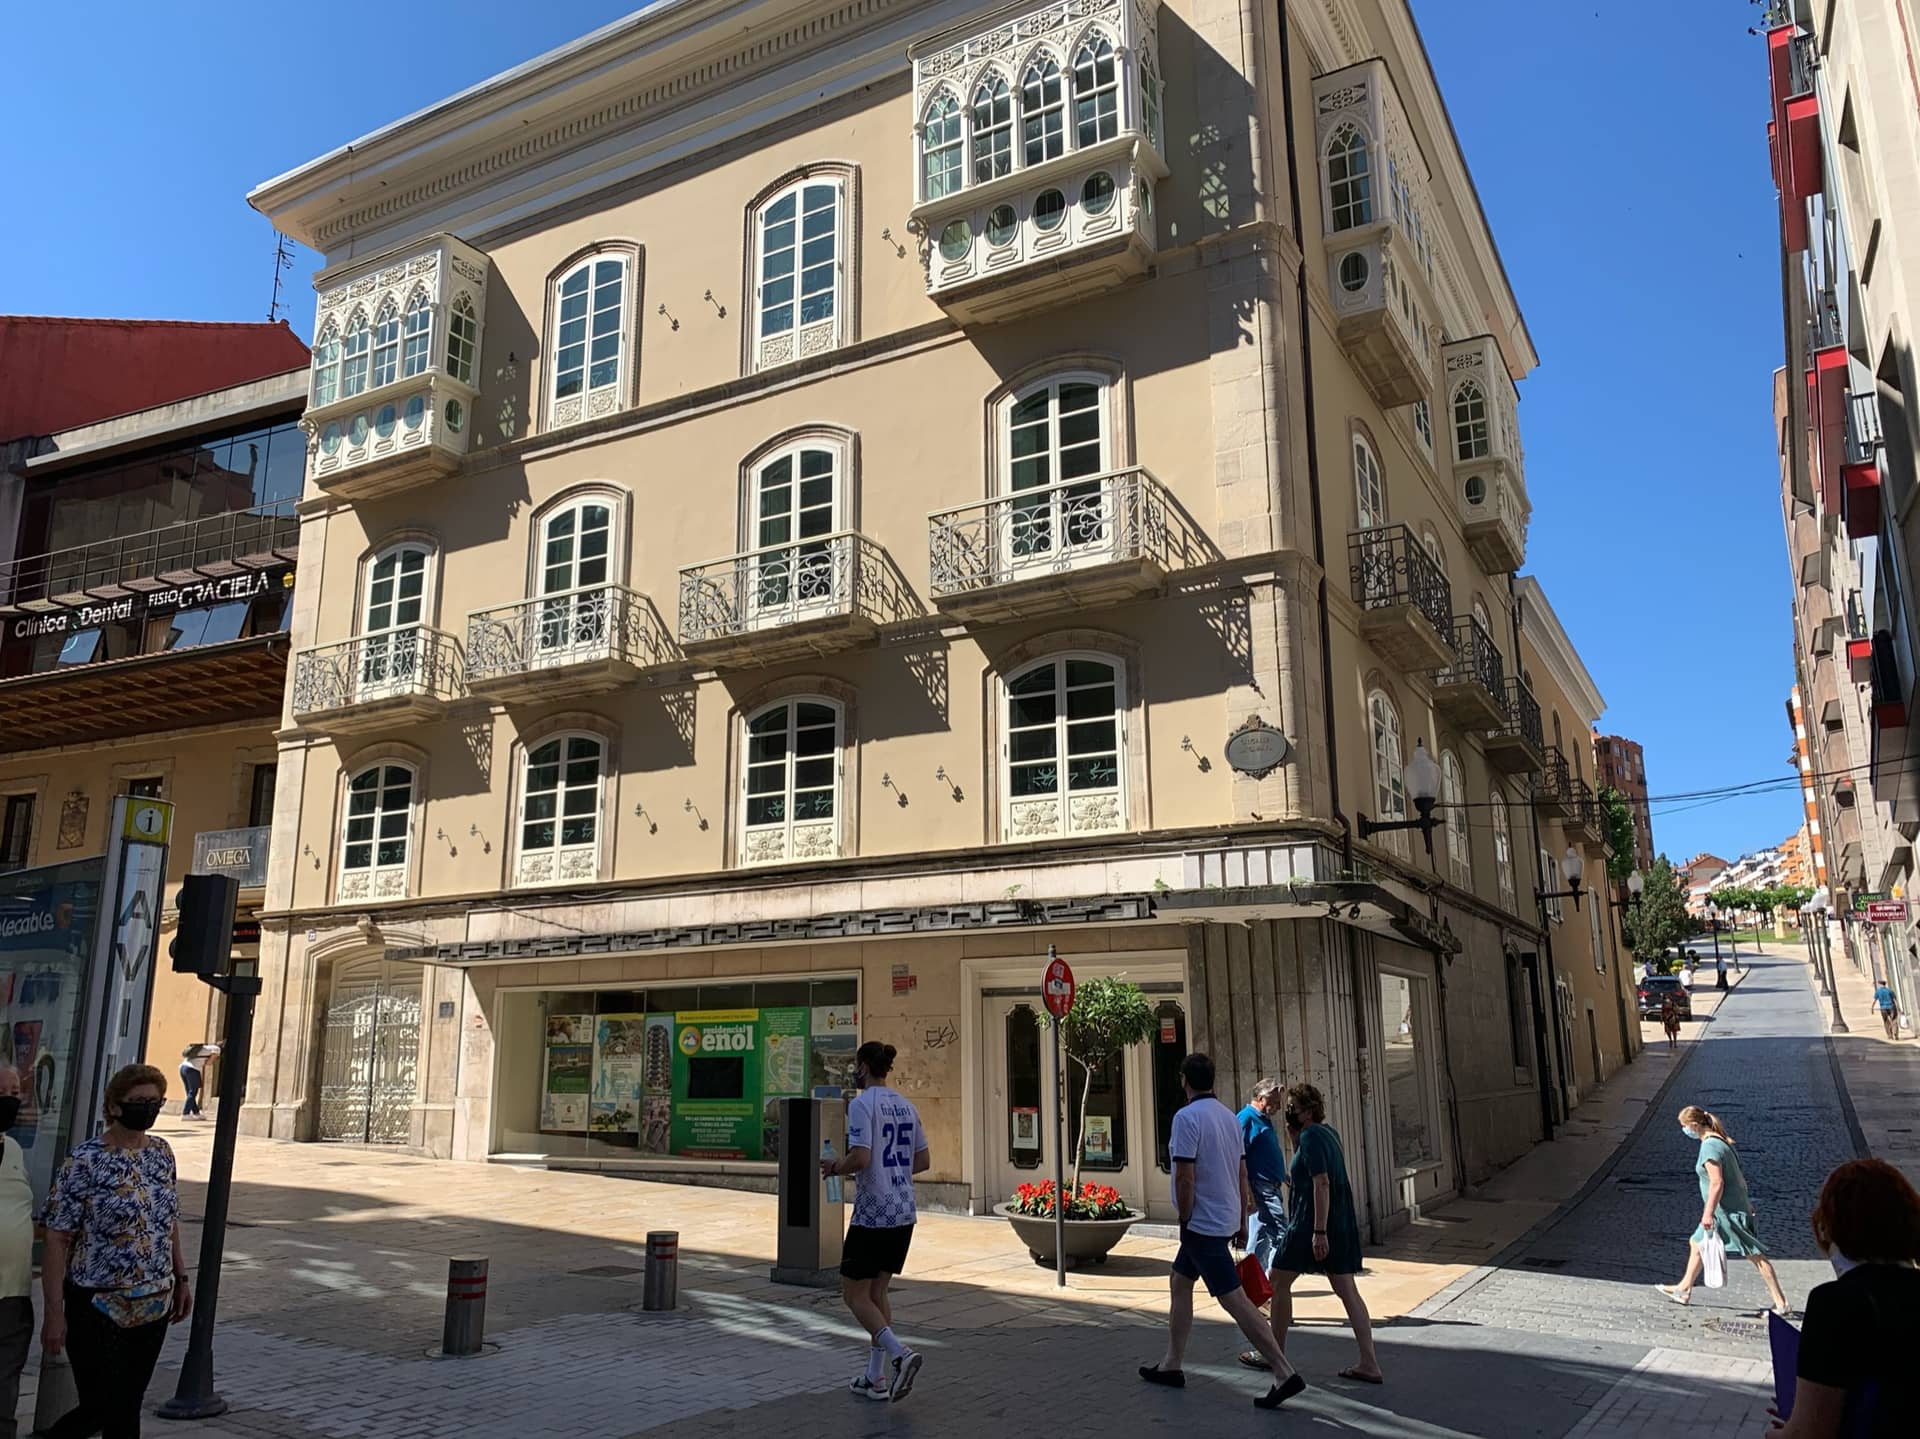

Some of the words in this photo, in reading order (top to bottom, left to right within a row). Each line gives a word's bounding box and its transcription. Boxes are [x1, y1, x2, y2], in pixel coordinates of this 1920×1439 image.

[15, 613, 67, 639] Clínica
[80, 598, 132, 627] Dental
[206, 849, 251, 866] OMEGA
[0, 911, 55, 937] lecable
[702, 1025, 755, 1051] enol
[882, 1122, 914, 1168] 25
